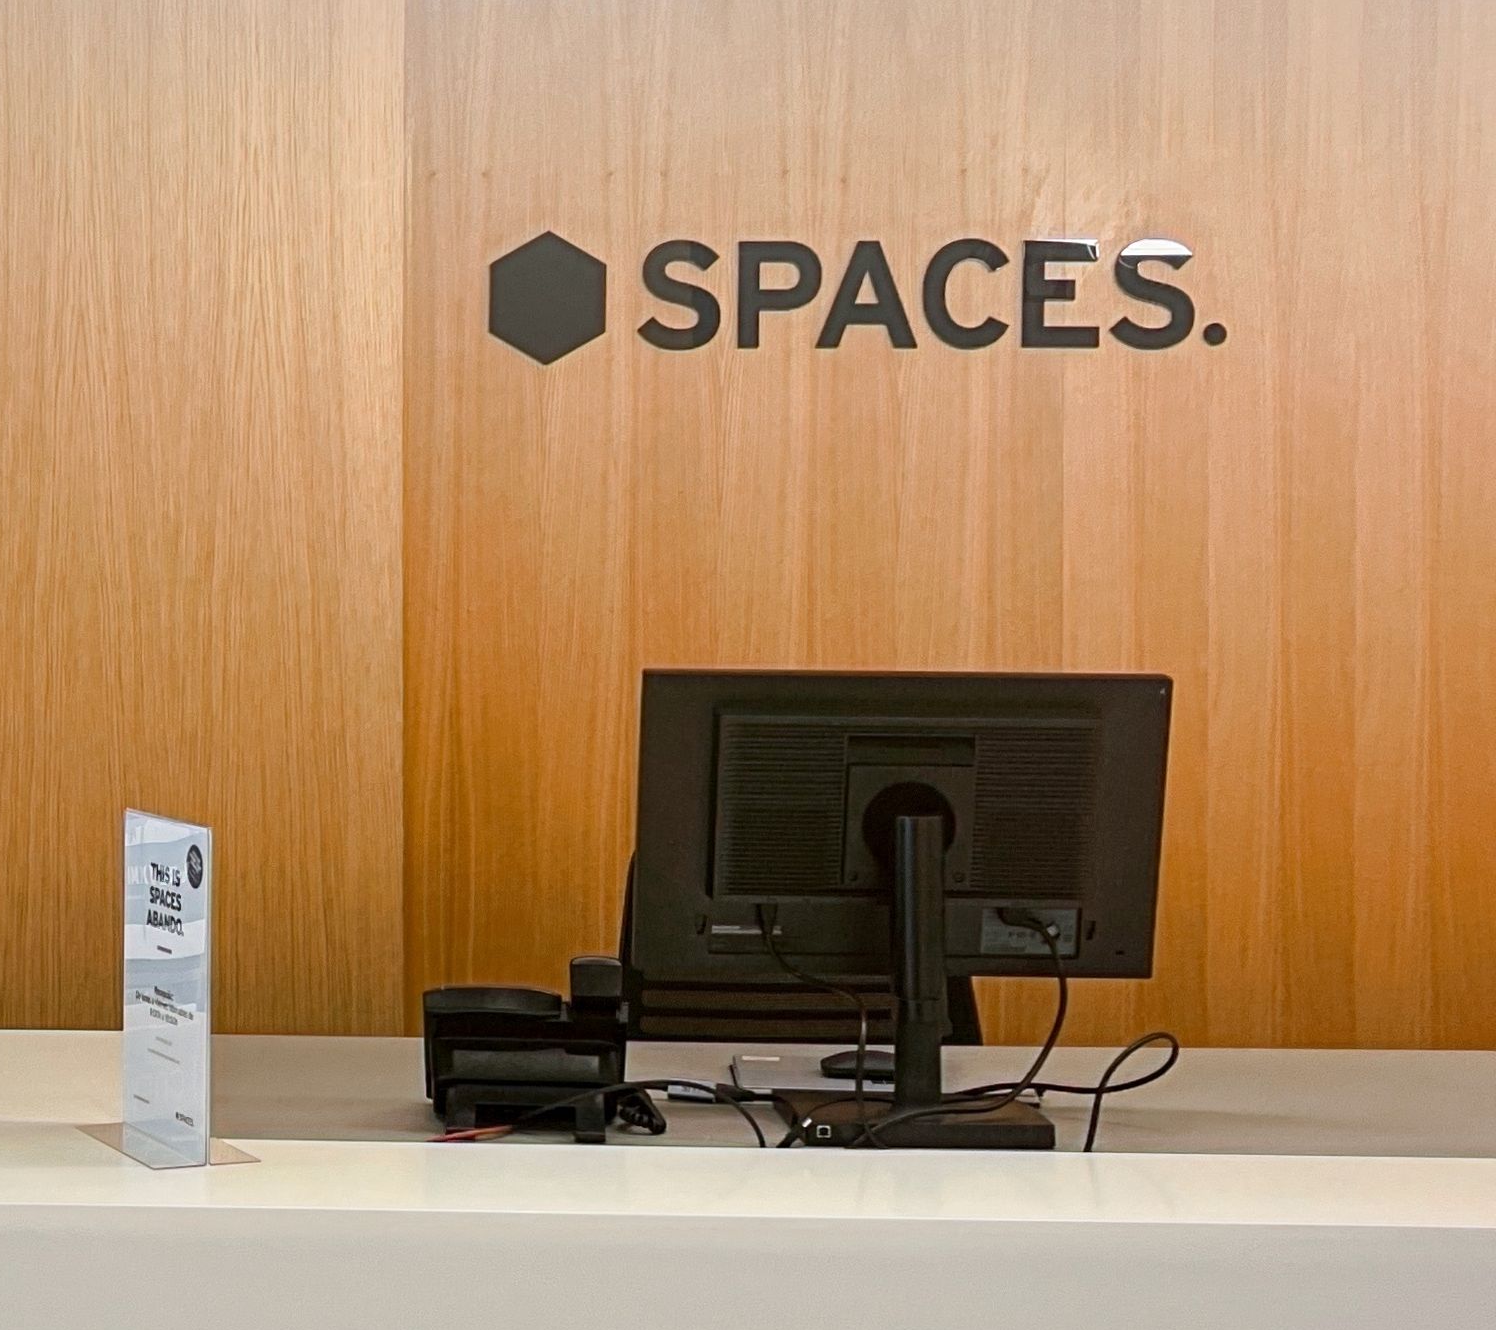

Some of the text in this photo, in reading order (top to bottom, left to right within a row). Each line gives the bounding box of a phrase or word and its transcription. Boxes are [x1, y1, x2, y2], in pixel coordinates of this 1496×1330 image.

[636, 237, 1227, 351] SPACES.
[151, 862, 170, 884] THIS
[172, 868, 180, 887] IS
[150, 886, 181, 911] SPACES
